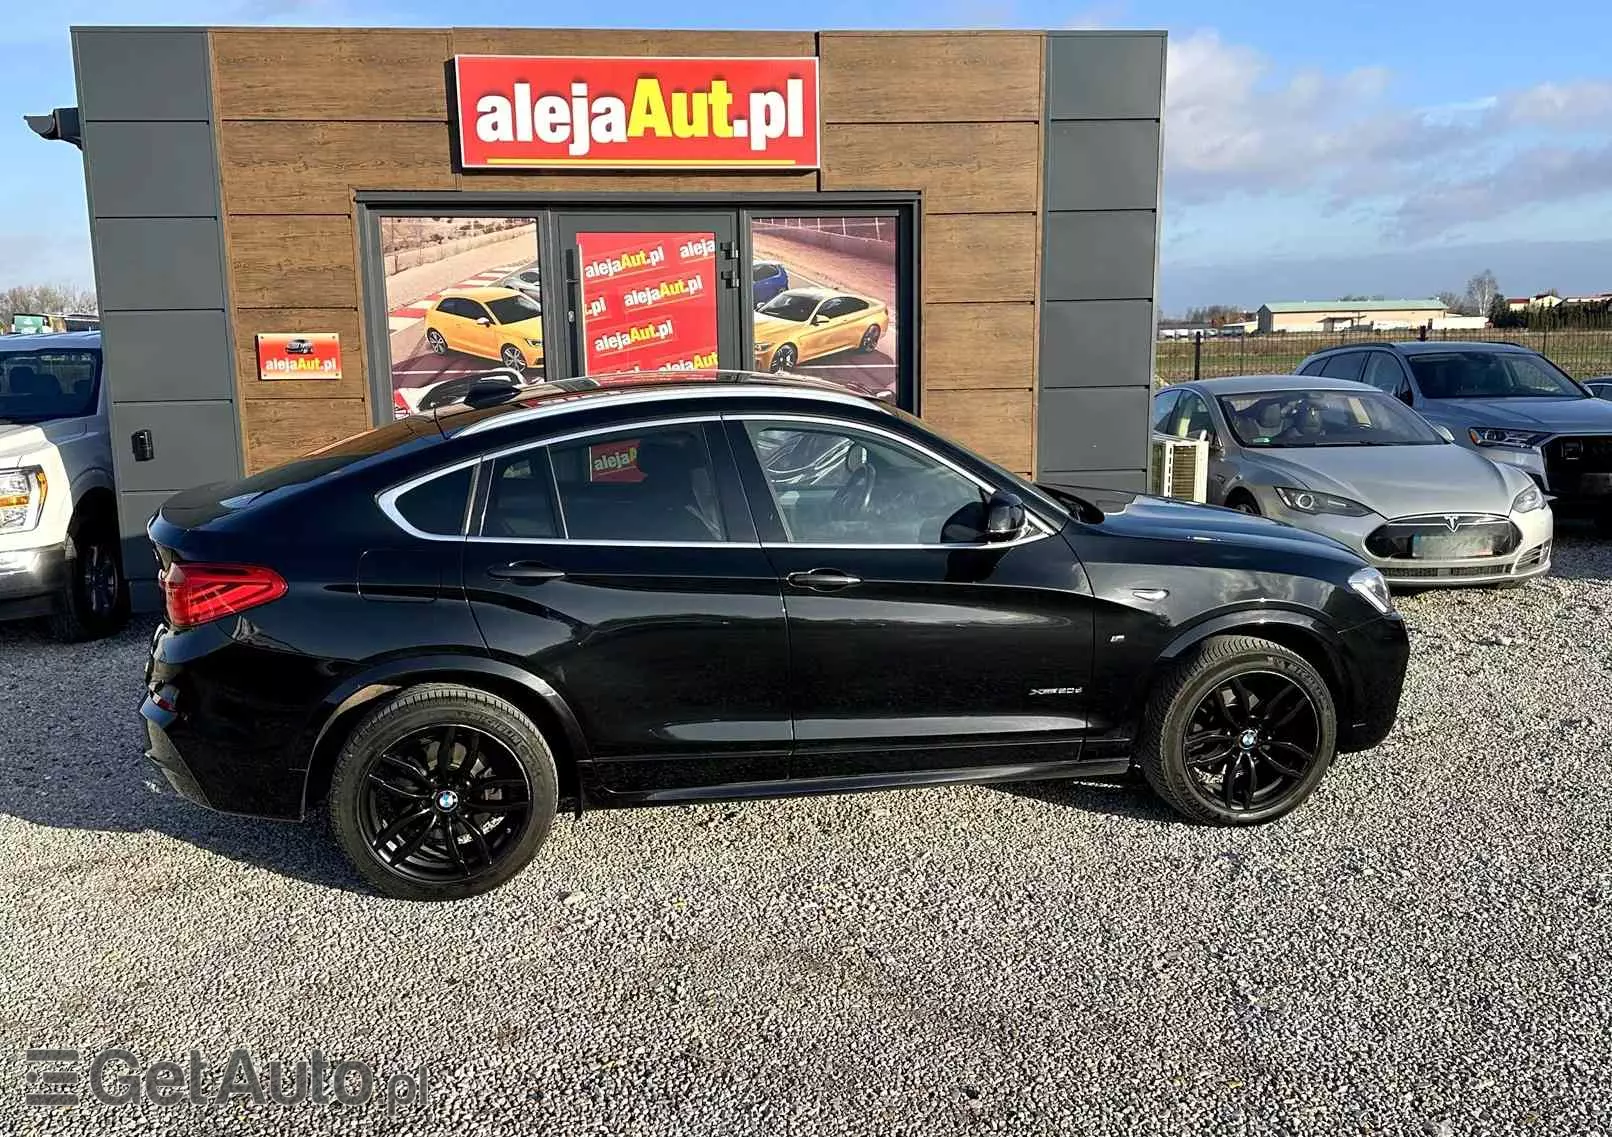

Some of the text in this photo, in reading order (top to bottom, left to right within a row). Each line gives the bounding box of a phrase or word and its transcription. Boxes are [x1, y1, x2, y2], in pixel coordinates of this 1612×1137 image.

[476, 77, 804, 157] alejaAut.pl
[585, 247, 664, 278] alejaAut.pl
[624, 275, 703, 307] alejaAut.pl
[595, 320, 673, 352] alejaAut.pl
[265, 358, 336, 372] alejaAut.pl
